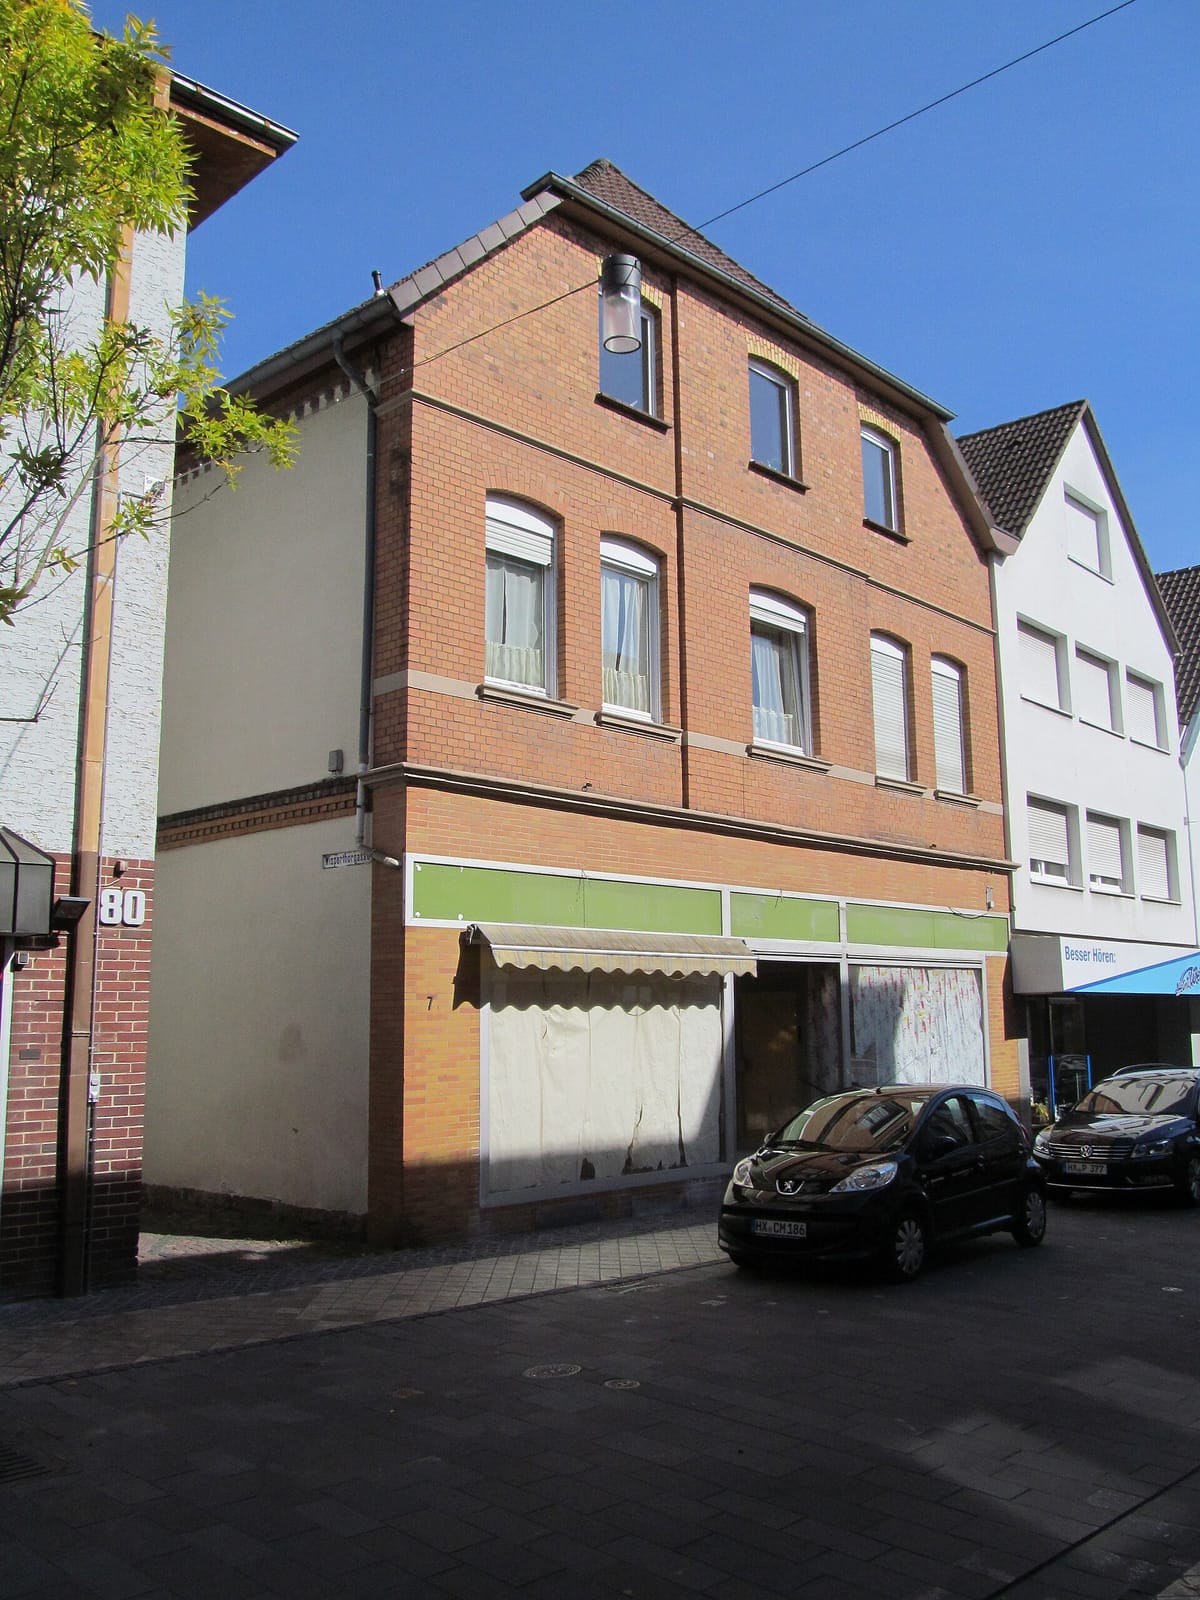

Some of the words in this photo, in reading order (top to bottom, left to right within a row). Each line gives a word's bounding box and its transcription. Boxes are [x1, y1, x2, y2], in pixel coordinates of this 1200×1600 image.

[100, 889, 145, 925] 80
[1065, 946, 1090, 961] Besser
[1093, 948, 1116, 963] Hören:
[427, 996, 433, 1011] 7
[755, 1220, 768, 1232] HX
